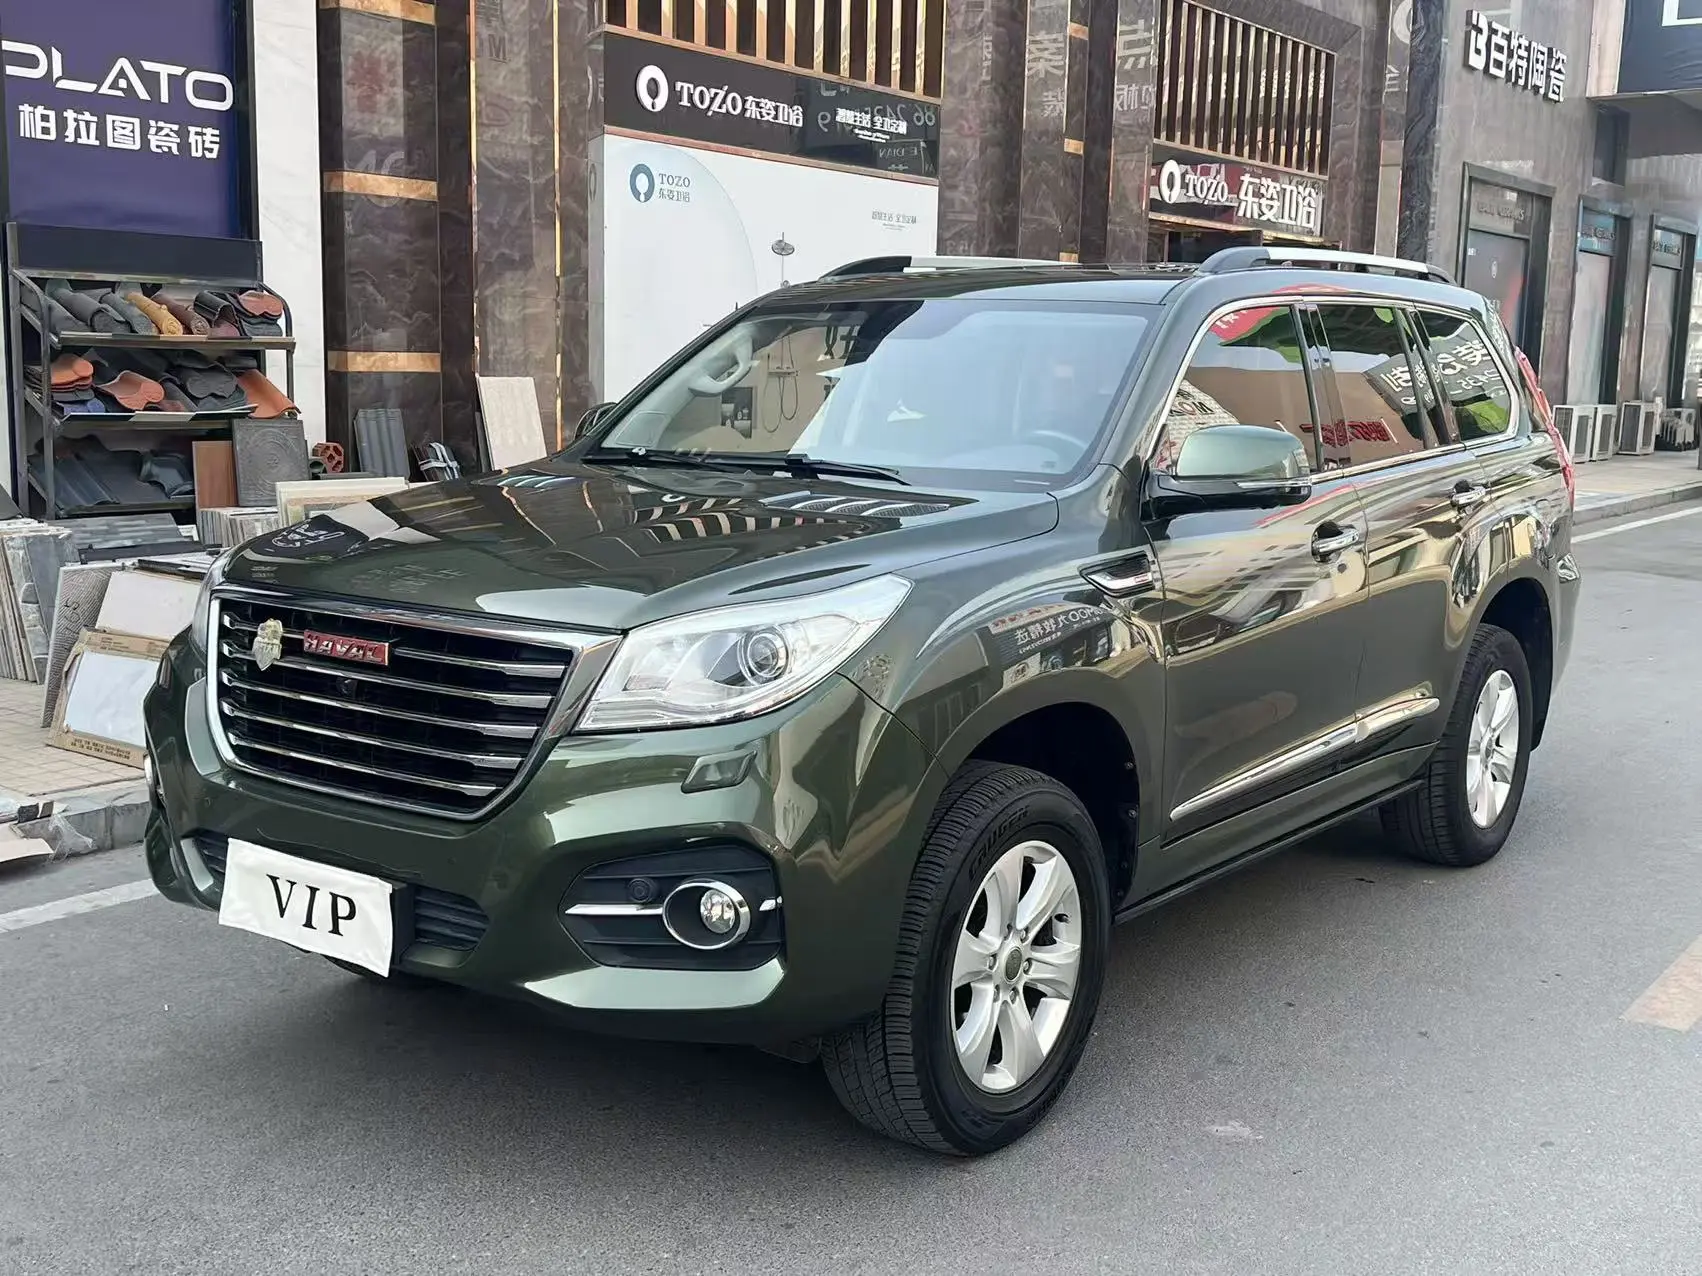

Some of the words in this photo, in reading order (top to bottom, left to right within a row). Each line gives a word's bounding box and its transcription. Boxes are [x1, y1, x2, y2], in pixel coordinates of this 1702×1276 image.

[1, 40, 234, 111] PLATO
[1489, 20, 1567, 102] 百特陶瓷
[18, 103, 220, 159] 柏拉图瓷砖
[675, 81, 742, 116] TOZO
[744, 95, 803, 128] 东姿卫浴
[658, 173, 690, 187] TOZO
[1185, 174, 1228, 204] TOZO
[1237, 173, 1317, 229] 东姿卫浴
[304, 635, 382, 662] HAVAL
[266, 874, 357, 937] VIP
